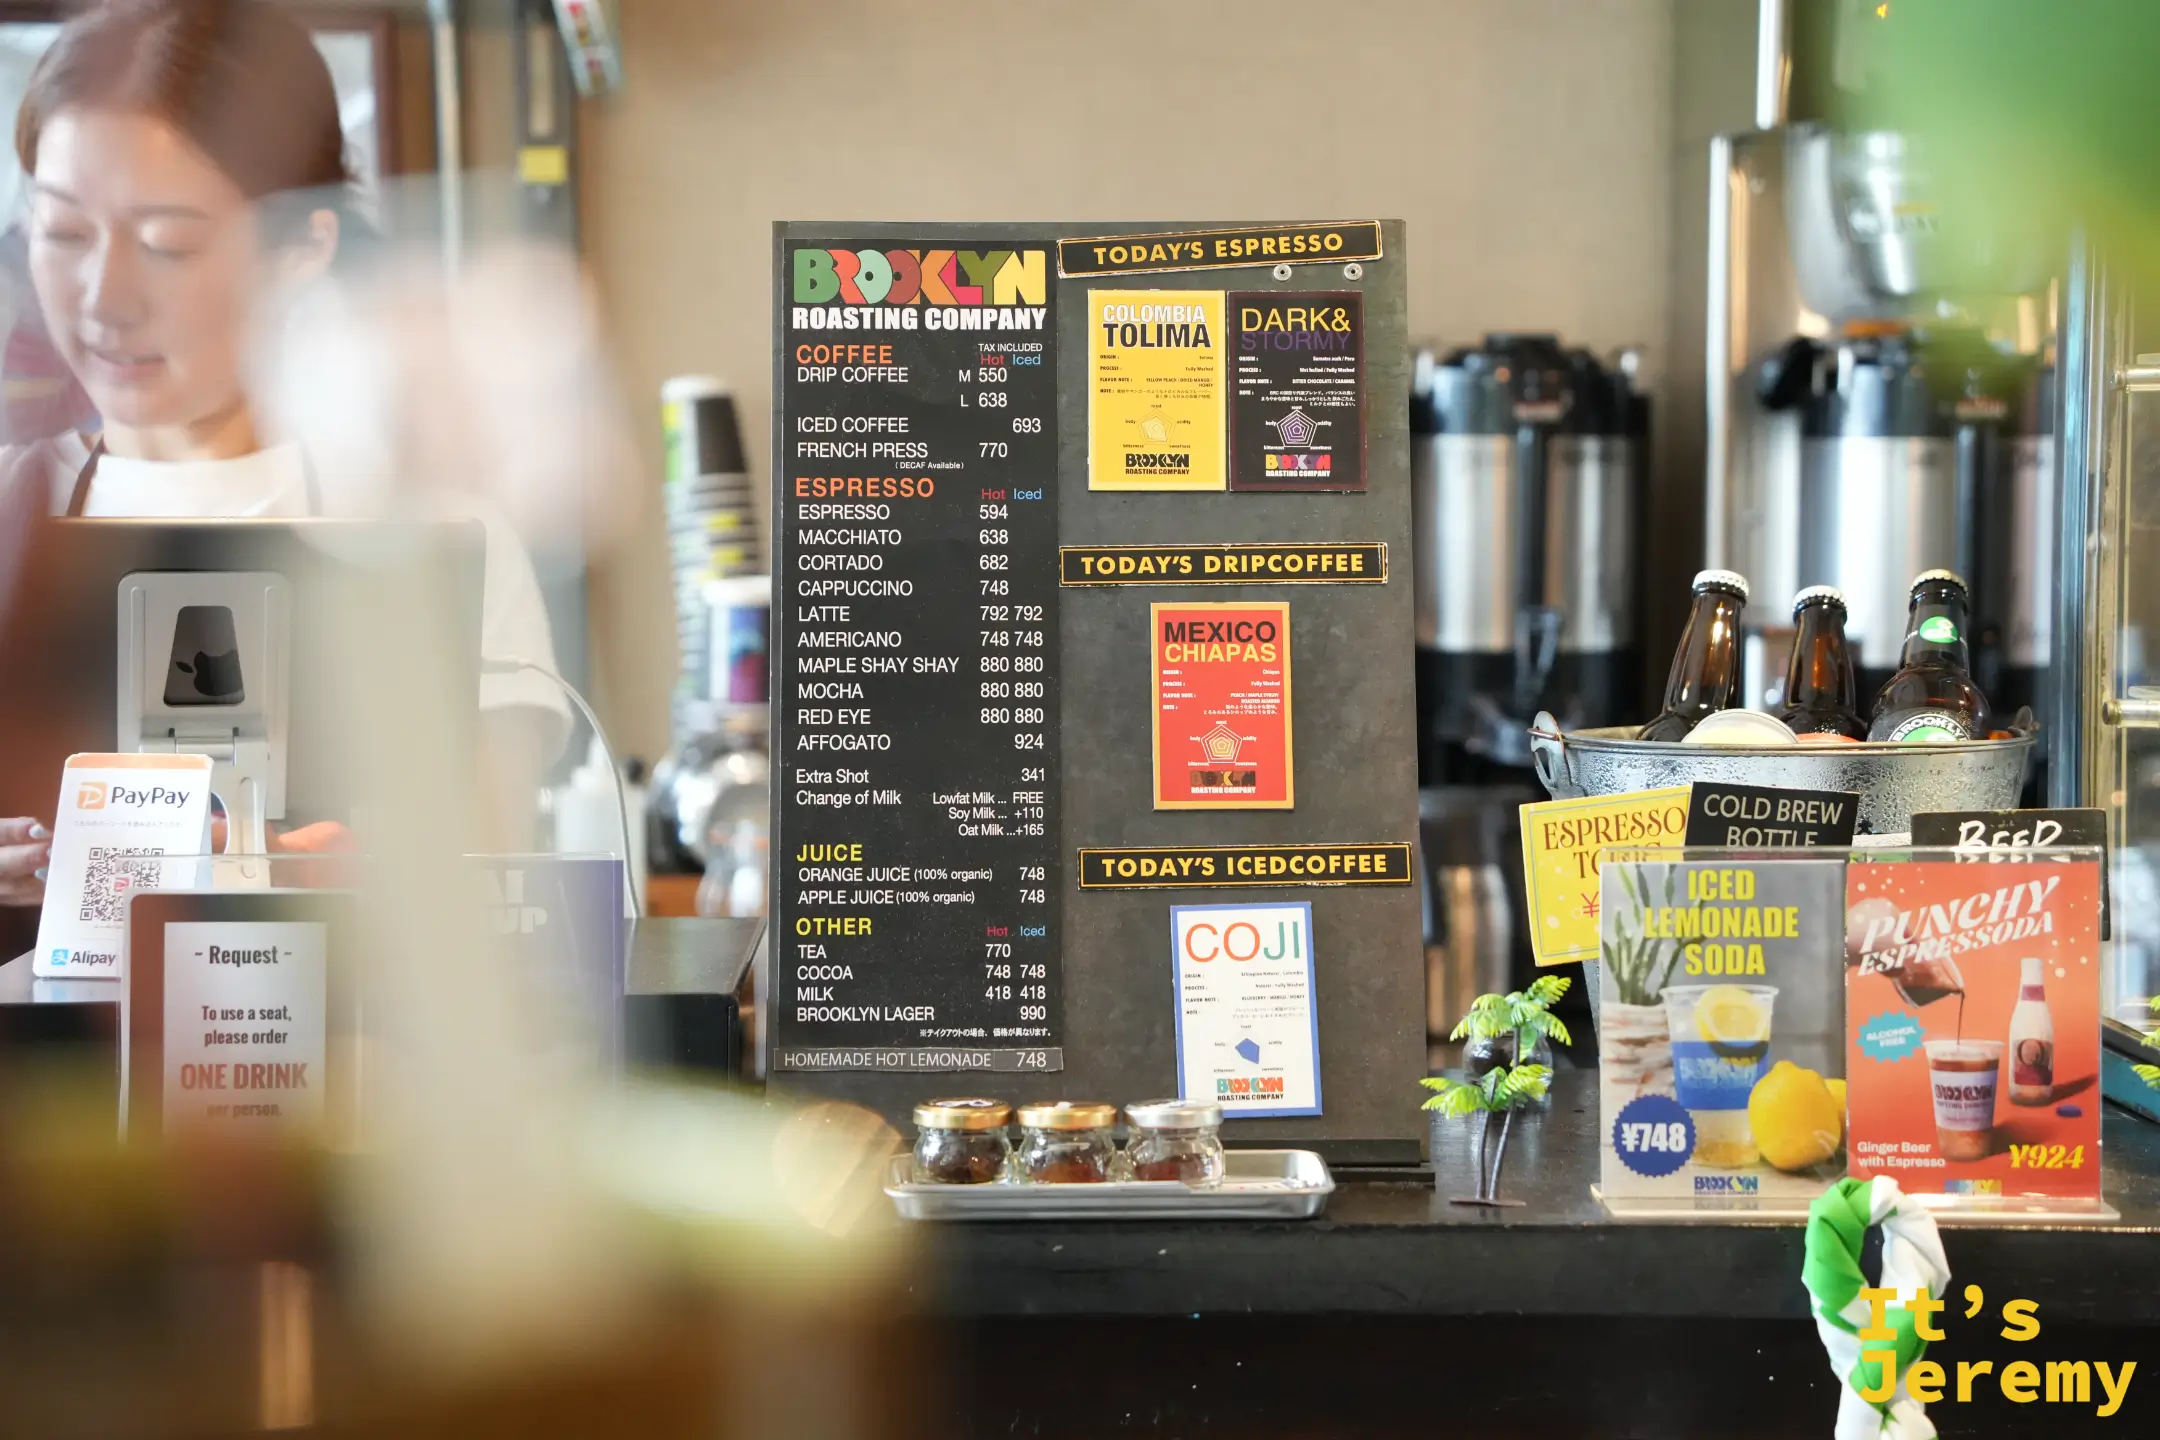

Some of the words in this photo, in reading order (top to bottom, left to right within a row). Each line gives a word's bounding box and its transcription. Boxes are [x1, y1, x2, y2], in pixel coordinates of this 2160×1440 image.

[1094, 242, 1204, 265] TODAY'S
[1215, 233, 1343, 258] ESPRESSO
[794, 249, 1046, 305] BROOKLYN
[792, 308, 918, 330] ROASTING
[925, 308, 1047, 330] COMPANY
[1103, 304, 1206, 323] COLOMBIA
[1242, 308, 1351, 332] DARK&
[1103, 323, 1211, 348] TOLIMA
[1242, 331, 1351, 351] STORMY
[796, 344, 893, 364] COFFEE
[978, 343, 995, 352] TAX
[997, 343, 1043, 352] INCLUDED
[980, 354, 1004, 365] Hot
[1012, 353, 1041, 365] Iced
[797, 367, 837, 383] DRIP
[842, 367, 909, 383] COFFEE
[959, 369, 971, 382] M
[978, 368, 1007, 383] 550
[960, 394, 969, 407] L
[978, 392, 1007, 408] 638
[797, 417, 837, 433] ICED
[842, 417, 909, 433] COFFEE
[1012, 418, 1041, 433] 693
[797, 442, 867, 458] FRENCH
[872, 442, 928, 458] PRESS
[979, 442, 1008, 458] 770
[927, 461, 964, 470] Available)
[795, 477, 934, 498] ESPRESSO
[981, 488, 1005, 500] Hot
[1013, 488, 1042, 500] Iced
[798, 504, 890, 520] ESPRESSO
[979, 504, 1008, 520] 594
[798, 529, 901, 545] MACCHIATO
[979, 529, 1008, 545] 638
[798, 555, 883, 570] CORTADO
[979, 555, 1008, 570] 682
[1081, 555, 1192, 575] TODAY'S
[1204, 553, 1363, 573] DRIPCOFFEE
[798, 580, 913, 596] CAPPUCCINO
[980, 580, 1009, 596] 748
[798, 606, 850, 622] LATTE
[980, 605, 1009, 621] 792
[1014, 605, 1042, 621] 792
[798, 631, 902, 647] AMERICANO
[980, 631, 1009, 647] 748
[1014, 631, 1043, 647] 748
[1165, 621, 1276, 643] MEXICO
[1165, 643, 1276, 663] CHIAPAS
[798, 657, 857, 673] MAPLE
[861, 657, 908, 673] SHAY
[912, 657, 959, 673] SHAY
[980, 657, 1009, 672] 880
[1014, 657, 1043, 672] 880
[798, 683, 864, 699] MOCHA
[980, 682, 1009, 698] 880
[1014, 682, 1043, 698] 880
[798, 709, 833, 725] RED
[838, 709, 871, 724] EYE
[980, 708, 1009, 723] 880
[1014, 708, 1044, 723] 880
[1893, 716, 1967, 740] BROOKLY
[797, 735, 891, 750] AFFOGATO
[1014, 734, 1044, 749] 924
[796, 769, 832, 784] Extra
[836, 768, 869, 784] Shot
[1021, 768, 1045, 782] 341
[111, 786, 190, 808] PayPay
[796, 790, 851, 808] Change
[855, 790, 869, 805] of
[873, 790, 901, 805] Milk
[933, 792, 970, 805] Lowfat
[972, 792, 995, 805] Milk
[1013, 792, 1044, 804] FREE
[949, 807, 970, 821] Soy
[972, 807, 995, 819] Milk
[1014, 807, 1044, 819] +110
[1703, 793, 1771, 820] COLD
[1777, 797, 1843, 825] BREW
[958, 824, 978, 836] Oat
[981, 824, 1003, 836] Milk
[1543, 806, 1686, 850] ESPRESSO
[796, 844, 863, 862] JUICE
[1102, 857, 1215, 877] TODAY'S
[1227, 854, 1387, 875] ICEDCOFFEE
[798, 867, 862, 882] ORANGE
[867, 867, 910, 882] JUICE
[914, 868, 947, 882] (100%
[951, 868, 993, 882] organic)
[1020, 867, 1045, 880] 748
[1688, 869, 1755, 901] ICED
[798, 890, 846, 904] APPLE
[850, 890, 894, 904] JUICE
[896, 891, 930, 905] (100%
[933, 891, 975, 905] organic)
[1020, 889, 1045, 903] 748
[1644, 907, 1799, 938] LEMONADE
[1859, 875, 2060, 954] PUNCHY
[796, 917, 872, 936] OTHER
[987, 926, 1008, 937] Hot
[1020, 926, 1045, 937] Iced
[1185, 921, 1300, 963] COJI
[1857, 911, 2052, 977] ESPRESSODA
[71, 950, 116, 967] Alipay
[209, 945, 278, 968] Request
[798, 944, 827, 959] TEA
[985, 944, 1011, 958] 770
[1684, 944, 1766, 976] SODA
[797, 965, 853, 980] COCOA
[985, 965, 1011, 979] 748
[1020, 965, 1045, 979] 748
[797, 987, 834, 1001] MILK
[985, 986, 1011, 1000] 418
[1020, 985, 1045, 1000] 418
[201, 1005, 217, 1021] To
[220, 1009, 244, 1021] use
[247, 1009, 256, 1021] a
[259, 1005, 292, 1022] seat,
[797, 1007, 880, 1022] BROOKLYN
[884, 1007, 934, 1021] LAGER
[1020, 1006, 1046, 1020] 990
[204, 1029, 248, 1047] please
[252, 1029, 288, 1044] order
[784, 1053, 872, 1067] HOMEMADE
[876, 1053, 906, 1067] HOT
[910, 1053, 991, 1067] LEMONADE
[1016, 1052, 1046, 1067] 748
[180, 1063, 227, 1090] ONE
[233, 1062, 308, 1090] DRINK
[1621, 1123, 1686, 1153] ¥748
[1858, 1142, 1898, 1156] Ginger
[1901, 1142, 1931, 1153] Beer
[1858, 1155, 1884, 1167] with
[1887, 1155, 1945, 1169] Espresso
